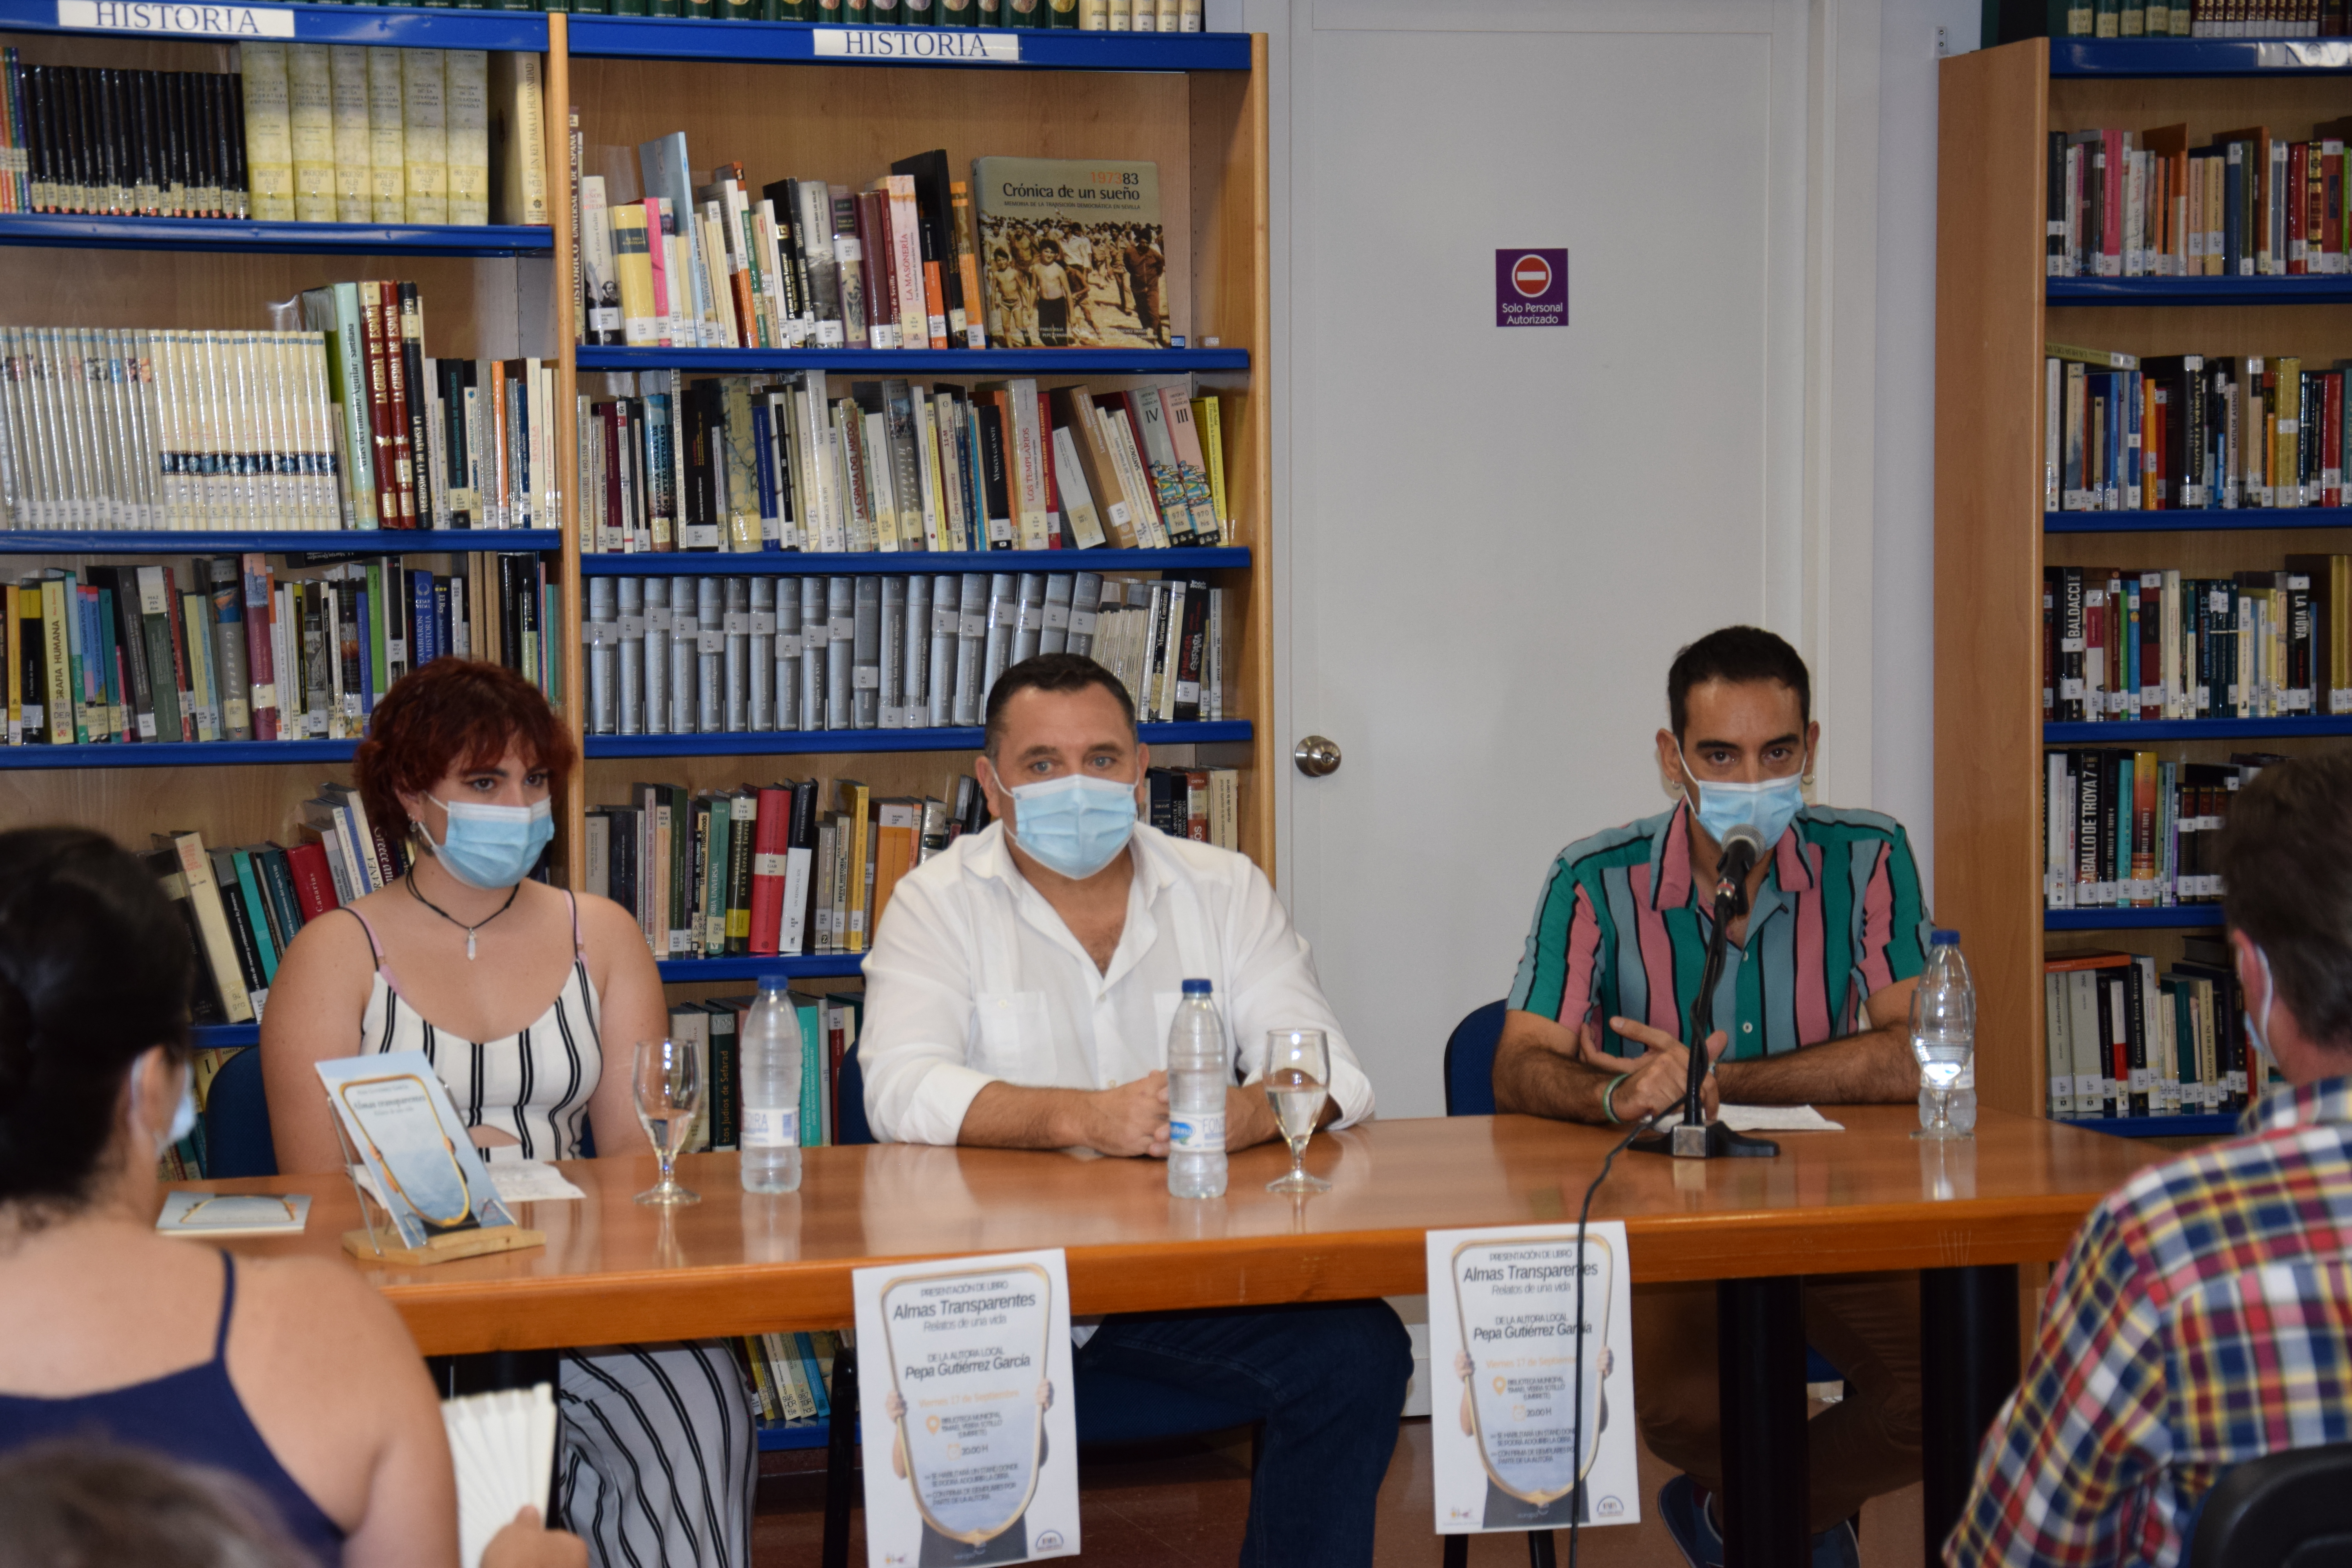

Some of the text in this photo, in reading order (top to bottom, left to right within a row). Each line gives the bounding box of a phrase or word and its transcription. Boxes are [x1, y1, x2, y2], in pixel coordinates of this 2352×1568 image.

[94, 2, 262, 34] HISTORIA
[844, 31, 989, 56] HISTORIA
[1003, 183, 1140, 200] Crónica de un sueño
[901, 233, 913, 301] LA MASONERÍA
[1503, 303, 1563, 312] Solo Personal
[1507, 315, 1558, 324] Autorizado
[1145, 408, 1158, 423] IV
[1176, 408, 1188, 423] III
[846, 421, 857, 454] MIEDO
[413, 416, 428, 513] LA ESPAÑA DE LA POSGUERRA
[851, 456, 859, 470] DEL
[1023, 428, 1033, 482] TEMPLARIOS
[852, 472, 863, 507] ESPAÑA
[1160, 591, 1169, 624] Constante
[2067, 582, 2080, 639] BALDACCI
[2294, 595, 2307, 640] LA VIUDA
[51, 620, 62, 664] HUMANA
[2082, 779, 2097, 817] TROYA
[2082, 818, 2097, 834] DE
[309, 873, 323, 912] Canarias
[720, 1051, 731, 1143] Los Judíos de Sefarad
[1490, 1249, 1572, 1261] PRESENTACIÓN DE LIBRO
[1464, 1263, 1598, 1283] Almas Transparenes
[976, 1282, 985, 1292] DE
[987, 1280, 1009, 1291] LIBRO
[1492, 1281, 1571, 1295] Relatos de una vida
[894, 1293, 1036, 1321] Almas Transparentes
[924, 1314, 1007, 1332] Relatos de una vida
[1496, 1317, 1505, 1325] DE
[1517, 1314, 1545, 1323] AUTORA
[1546, 1313, 1568, 1322] LOCAL
[1474, 1320, 1592, 1343] Pepa Gutiérrez Garía
[927, 1347, 1004, 1363] DE LA AUTORA LOCAL
[906, 1353, 1031, 1381] Pepa Gutiérrez García
[782, 1394, 793, 1402] 946
[784, 1401, 797, 1409] HOR
